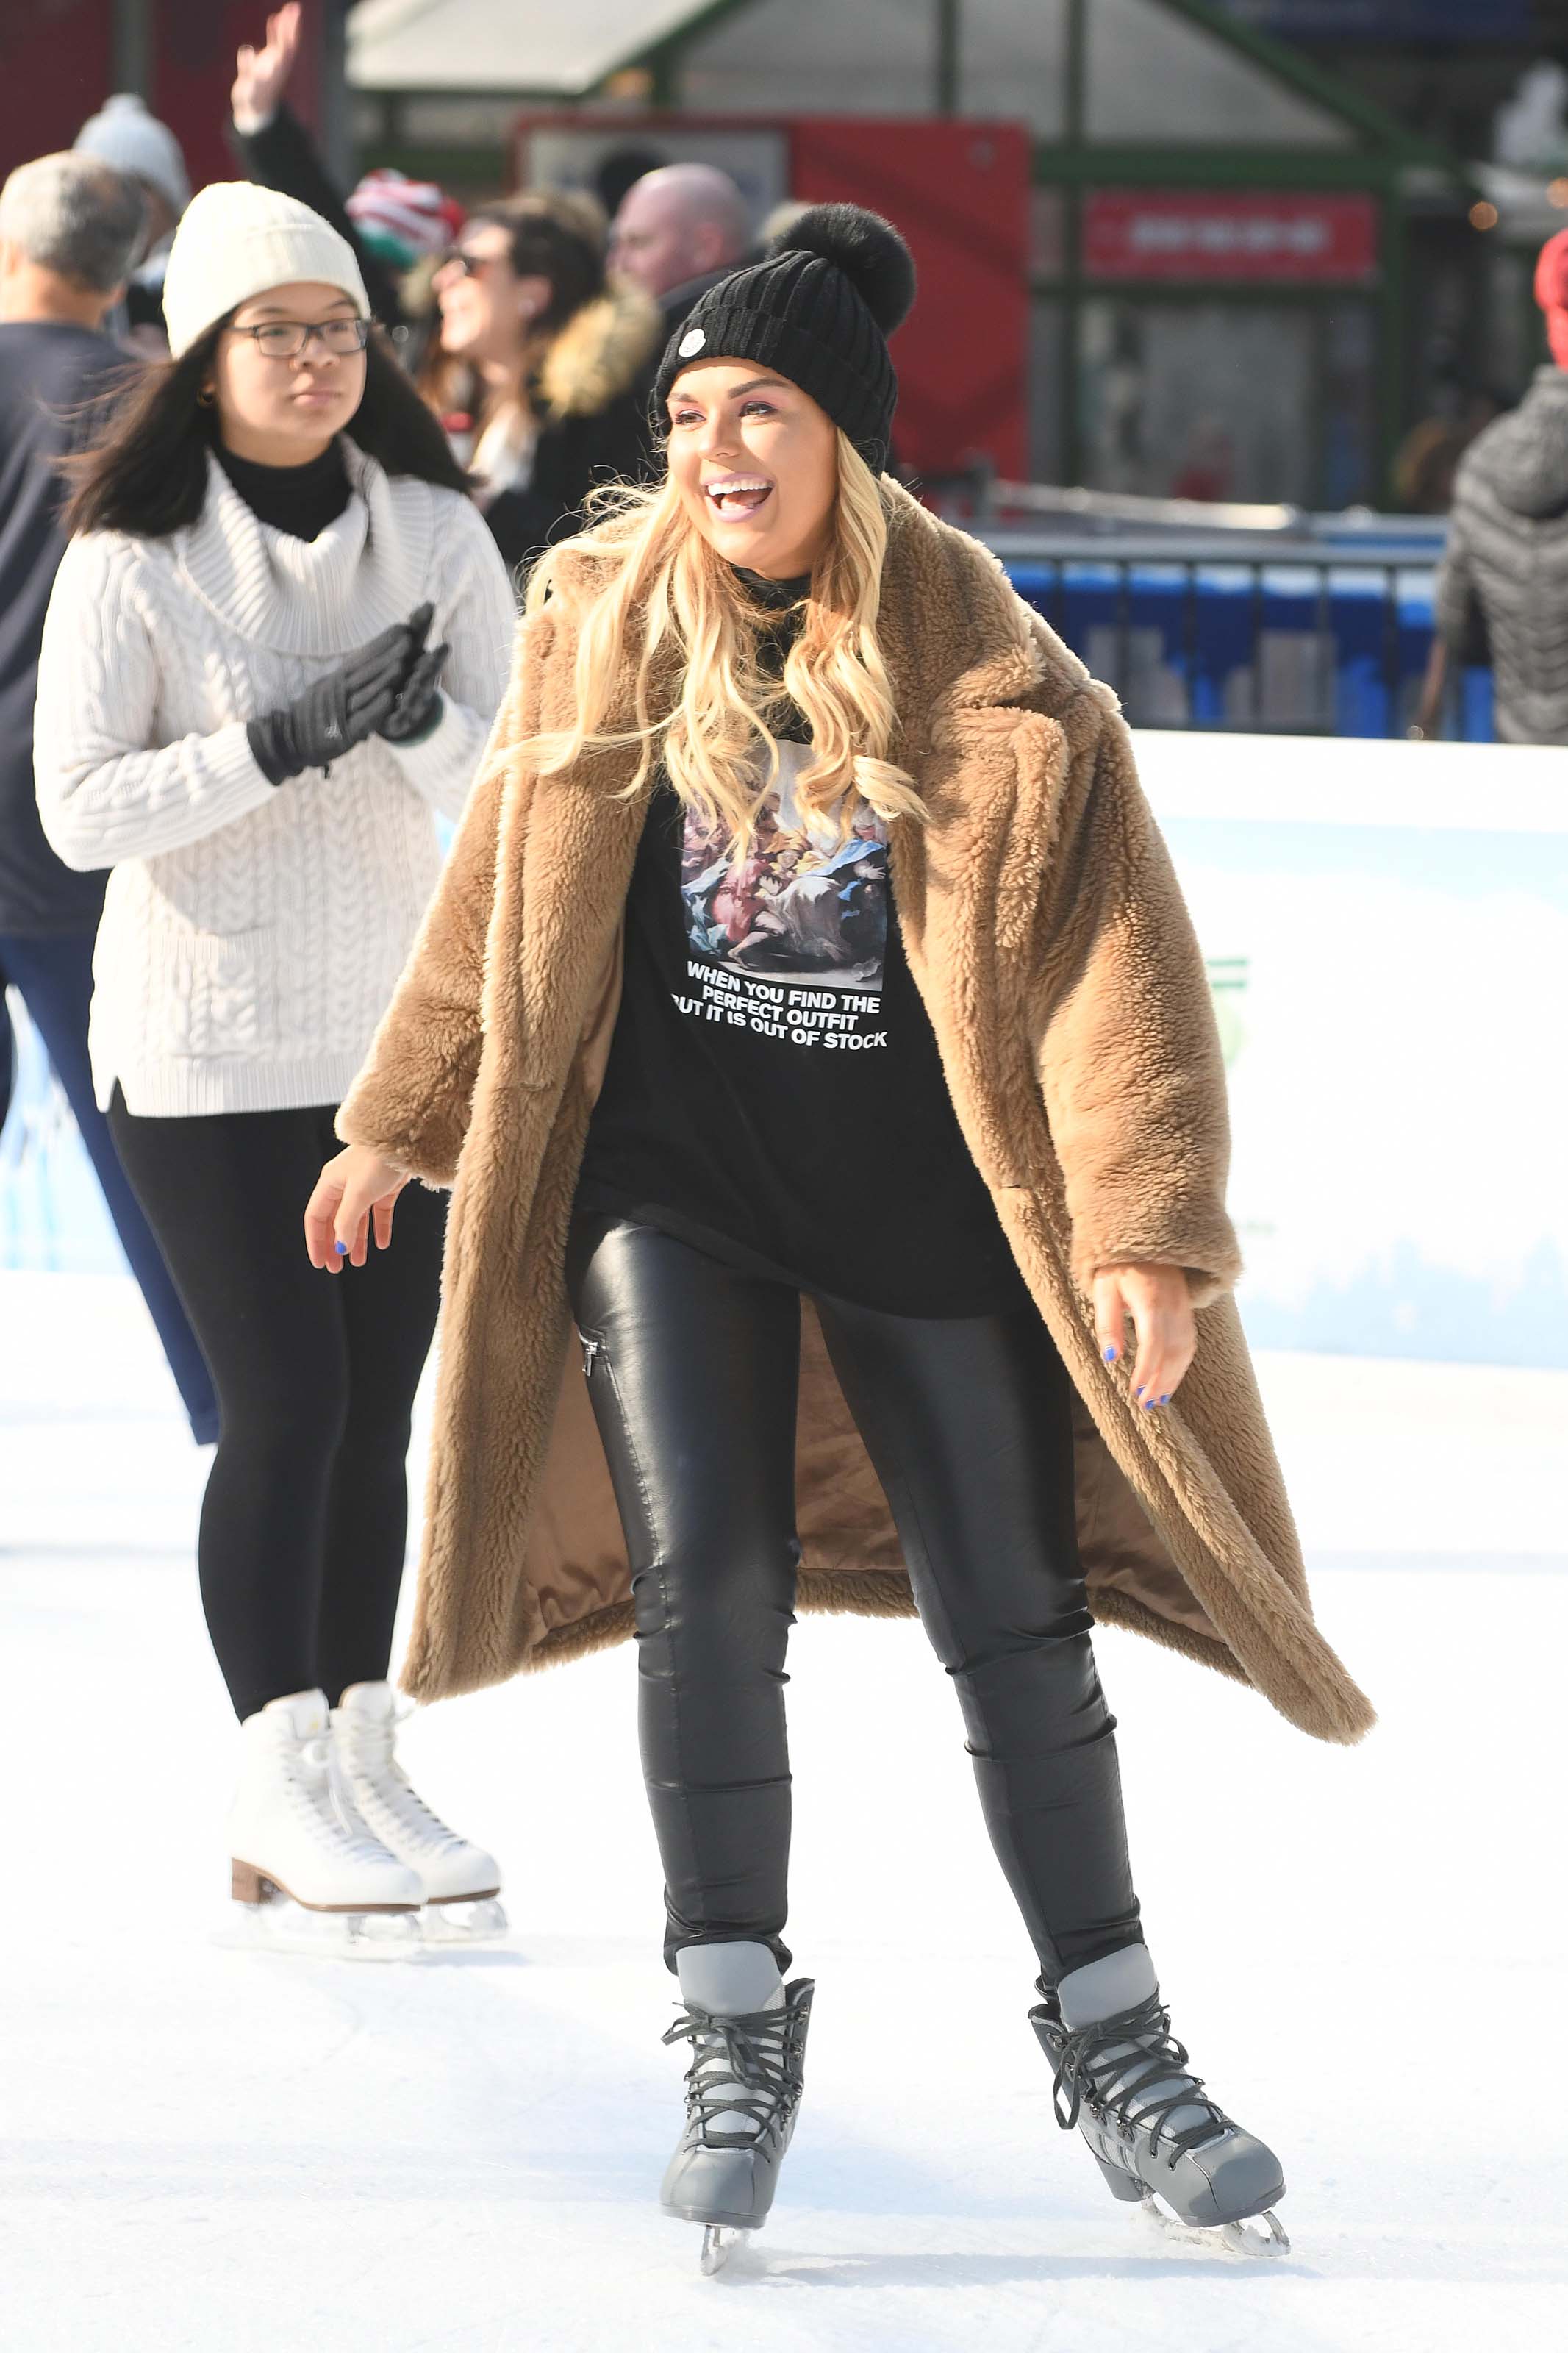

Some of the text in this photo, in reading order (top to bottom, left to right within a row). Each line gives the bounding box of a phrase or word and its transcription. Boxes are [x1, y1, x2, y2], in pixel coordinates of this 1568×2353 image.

[687, 960, 881, 1014] WHEN YOU FIND THE
[702, 985, 859, 1031] PERFECT OUTFIT
[706, 1004, 725, 1022] IT
[726, 1010, 747, 1026] IS
[750, 1017, 789, 1039] OUT
[791, 1028, 821, 1046] OF
[823, 1031, 888, 1051] STOCK
